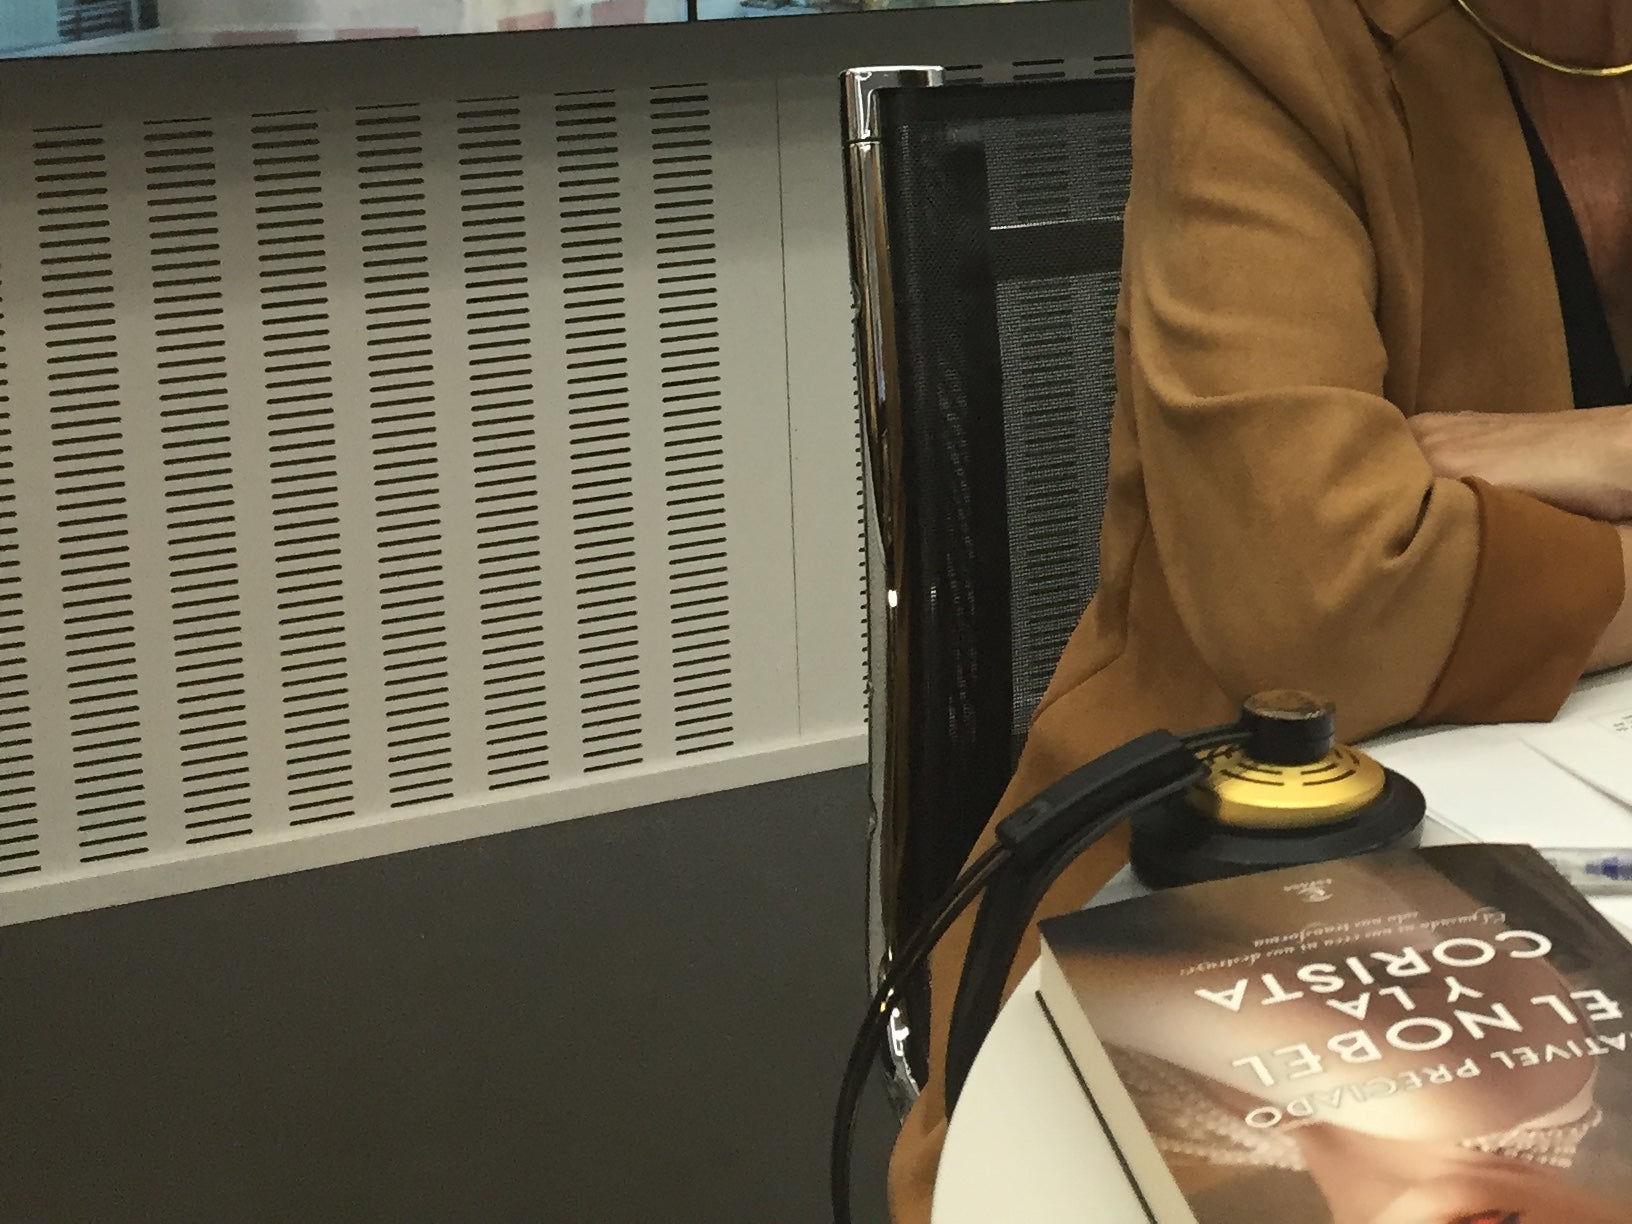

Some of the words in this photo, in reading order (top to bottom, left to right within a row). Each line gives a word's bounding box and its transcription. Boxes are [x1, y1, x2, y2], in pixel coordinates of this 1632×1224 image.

[1194, 929, 1553, 1012] CORISTA
[1444, 976, 1484, 1002] Y
[1326, 985, 1417, 1020] LA
[1529, 989, 1625, 1025] EL
[1231, 1003, 1523, 1088] NOBEL
[1244, 1058, 1482, 1129] PRECIADO
